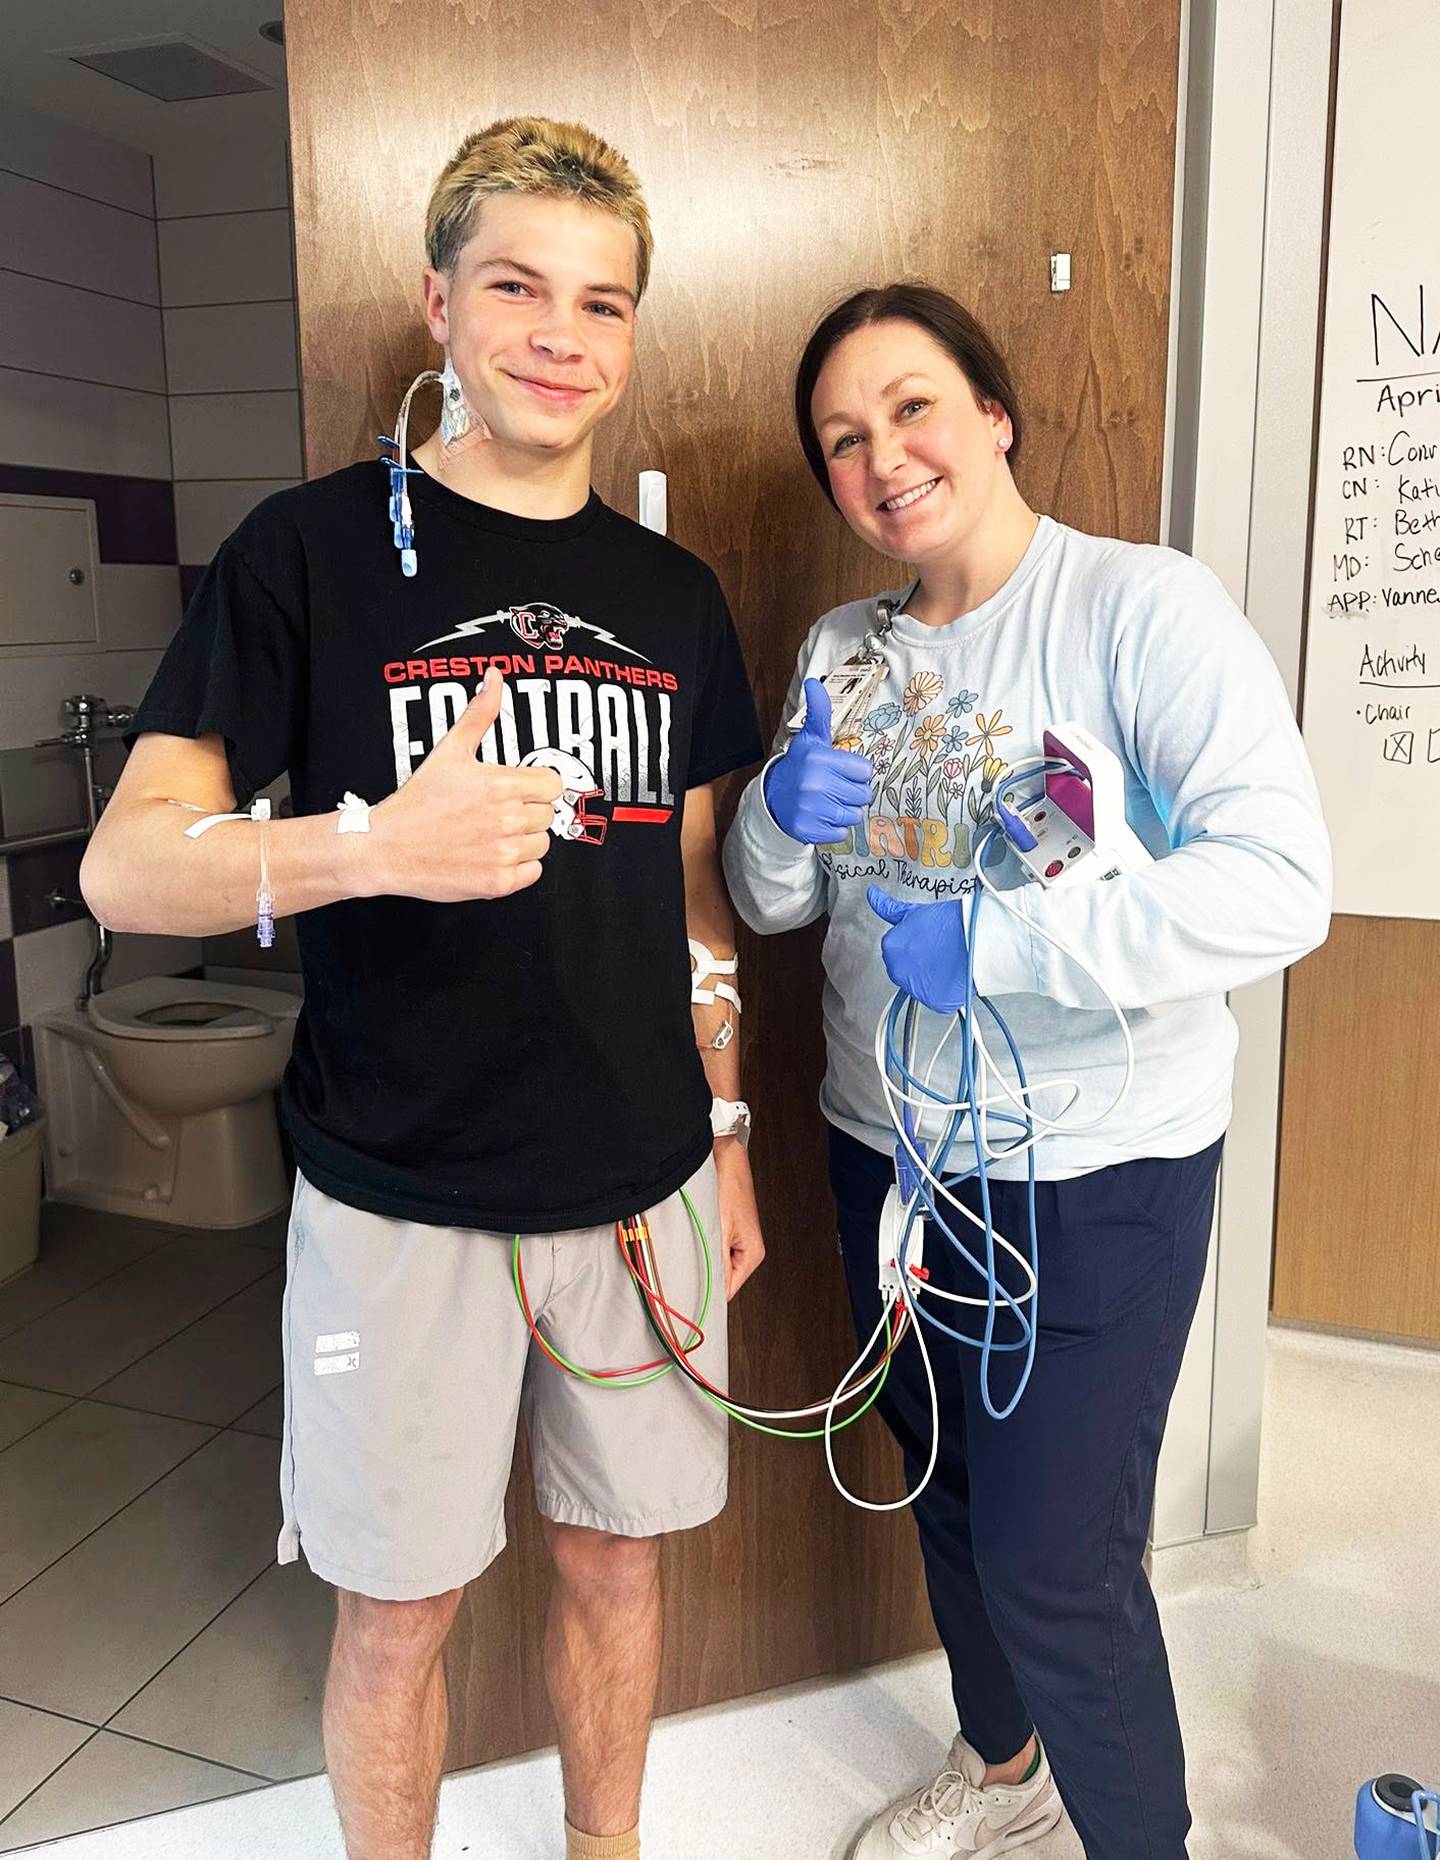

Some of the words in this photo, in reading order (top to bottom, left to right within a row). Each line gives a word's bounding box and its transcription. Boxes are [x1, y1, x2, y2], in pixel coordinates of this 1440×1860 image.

[383, 654, 536, 684] CRESTON
[544, 654, 679, 691] PANTHERS
[1359, 643, 1426, 678] Activity
